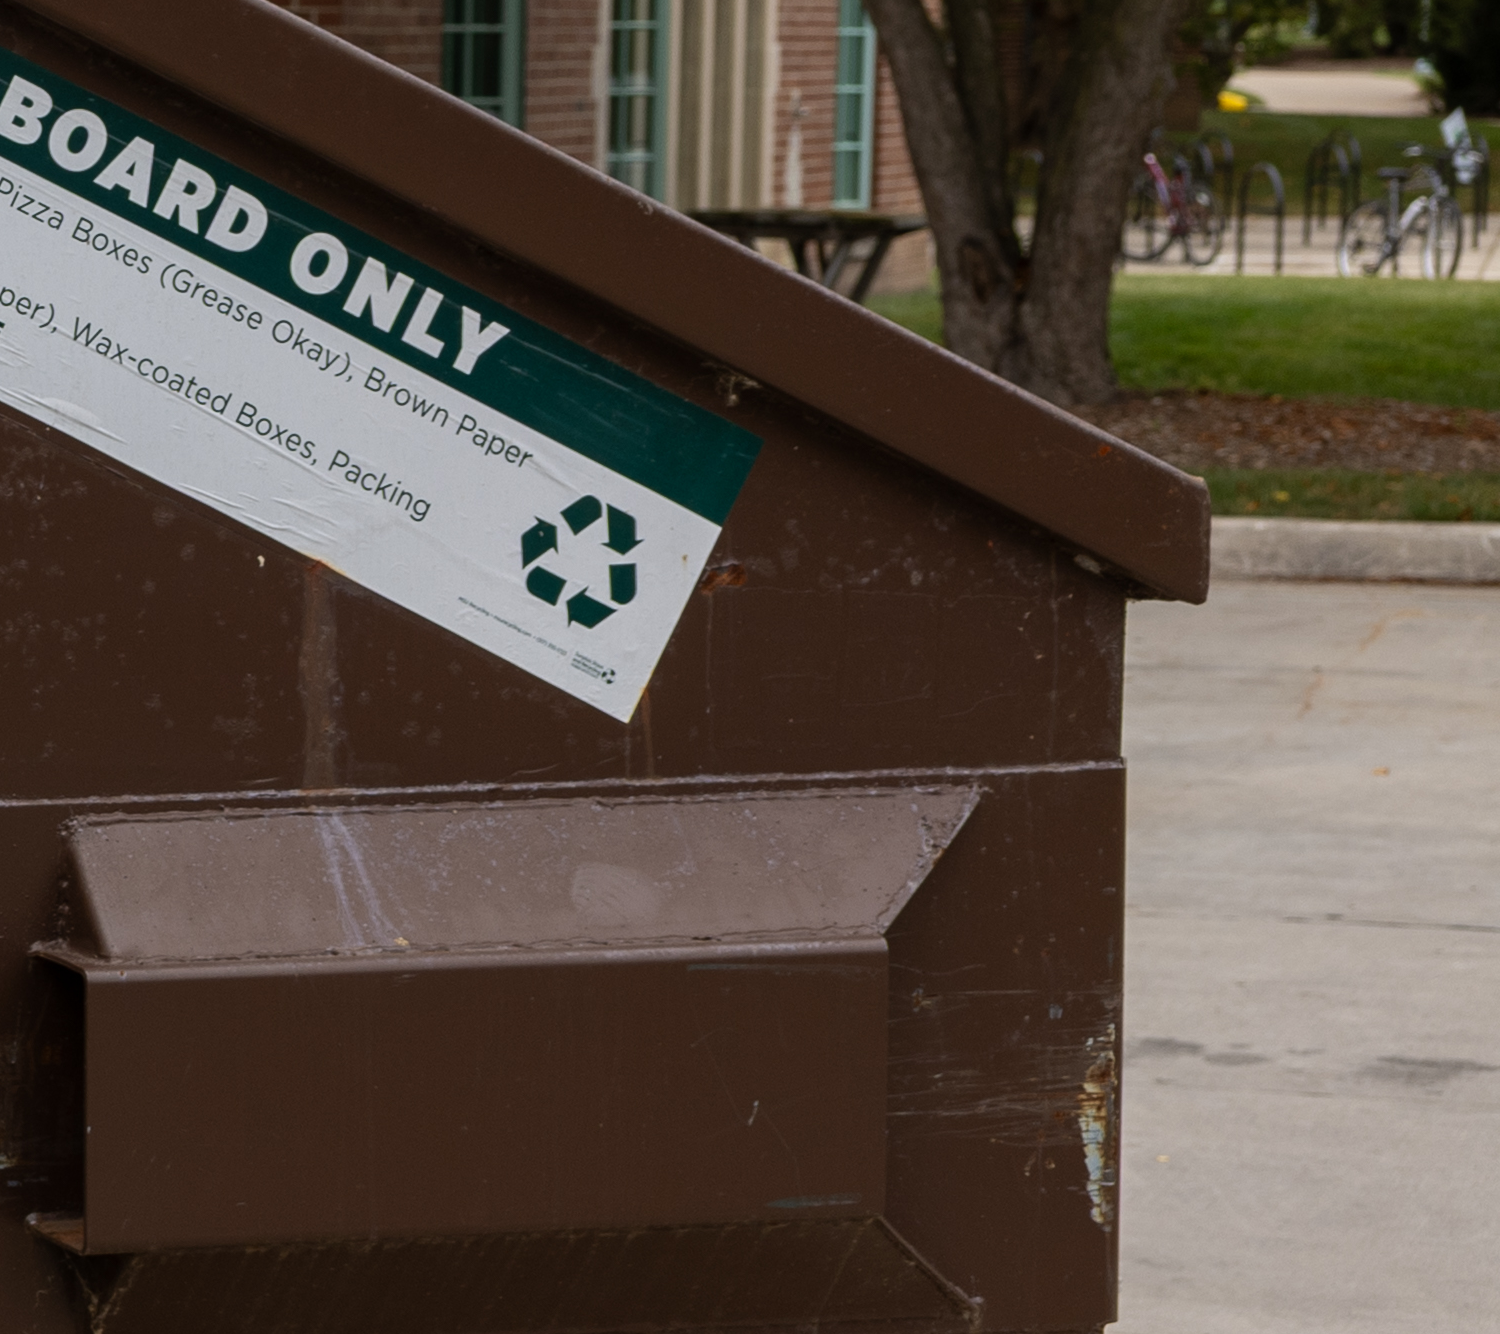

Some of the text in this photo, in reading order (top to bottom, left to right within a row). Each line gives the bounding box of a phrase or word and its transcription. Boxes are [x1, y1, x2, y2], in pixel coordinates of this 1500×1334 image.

[71, 216, 152, 274] Boxes
[159, 263, 262, 330] (Grease
[271, 319, 352, 381] Okay),
[363, 366, 448, 427] Brown
[455, 413, 532, 466] Paper
[290, 232, 510, 374] ONLY
[72, 317, 232, 414] Wax-coated
[235, 401, 316, 465] Boxes,
[328, 449, 430, 522] Packing
